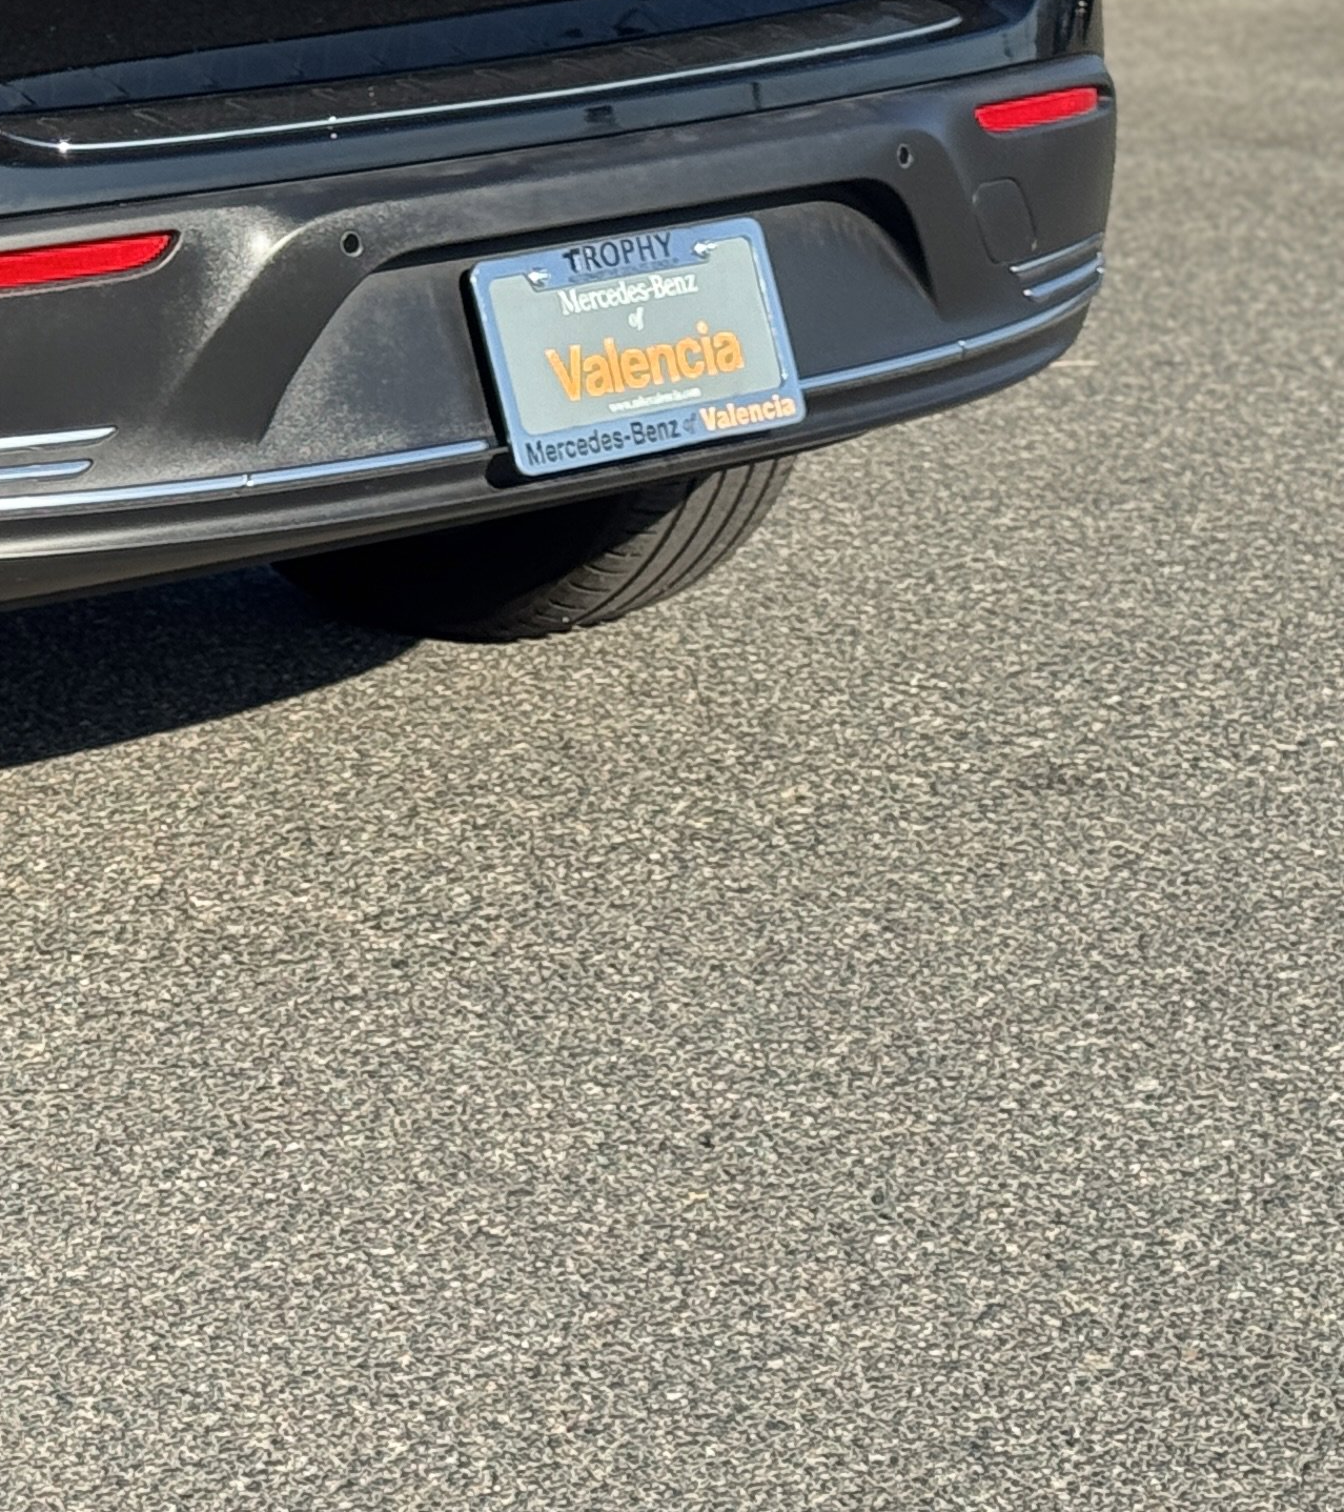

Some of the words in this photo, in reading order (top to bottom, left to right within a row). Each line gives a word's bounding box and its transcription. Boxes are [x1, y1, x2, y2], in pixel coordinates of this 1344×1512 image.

[563, 232, 671, 273] TROPHY
[557, 274, 699, 316] Mercedes-Benz
[628, 306, 645, 331] of
[545, 320, 745, 402] Valencia
[525, 419, 682, 466] Mercedes-Benz
[699, 394, 797, 431] Valencia
